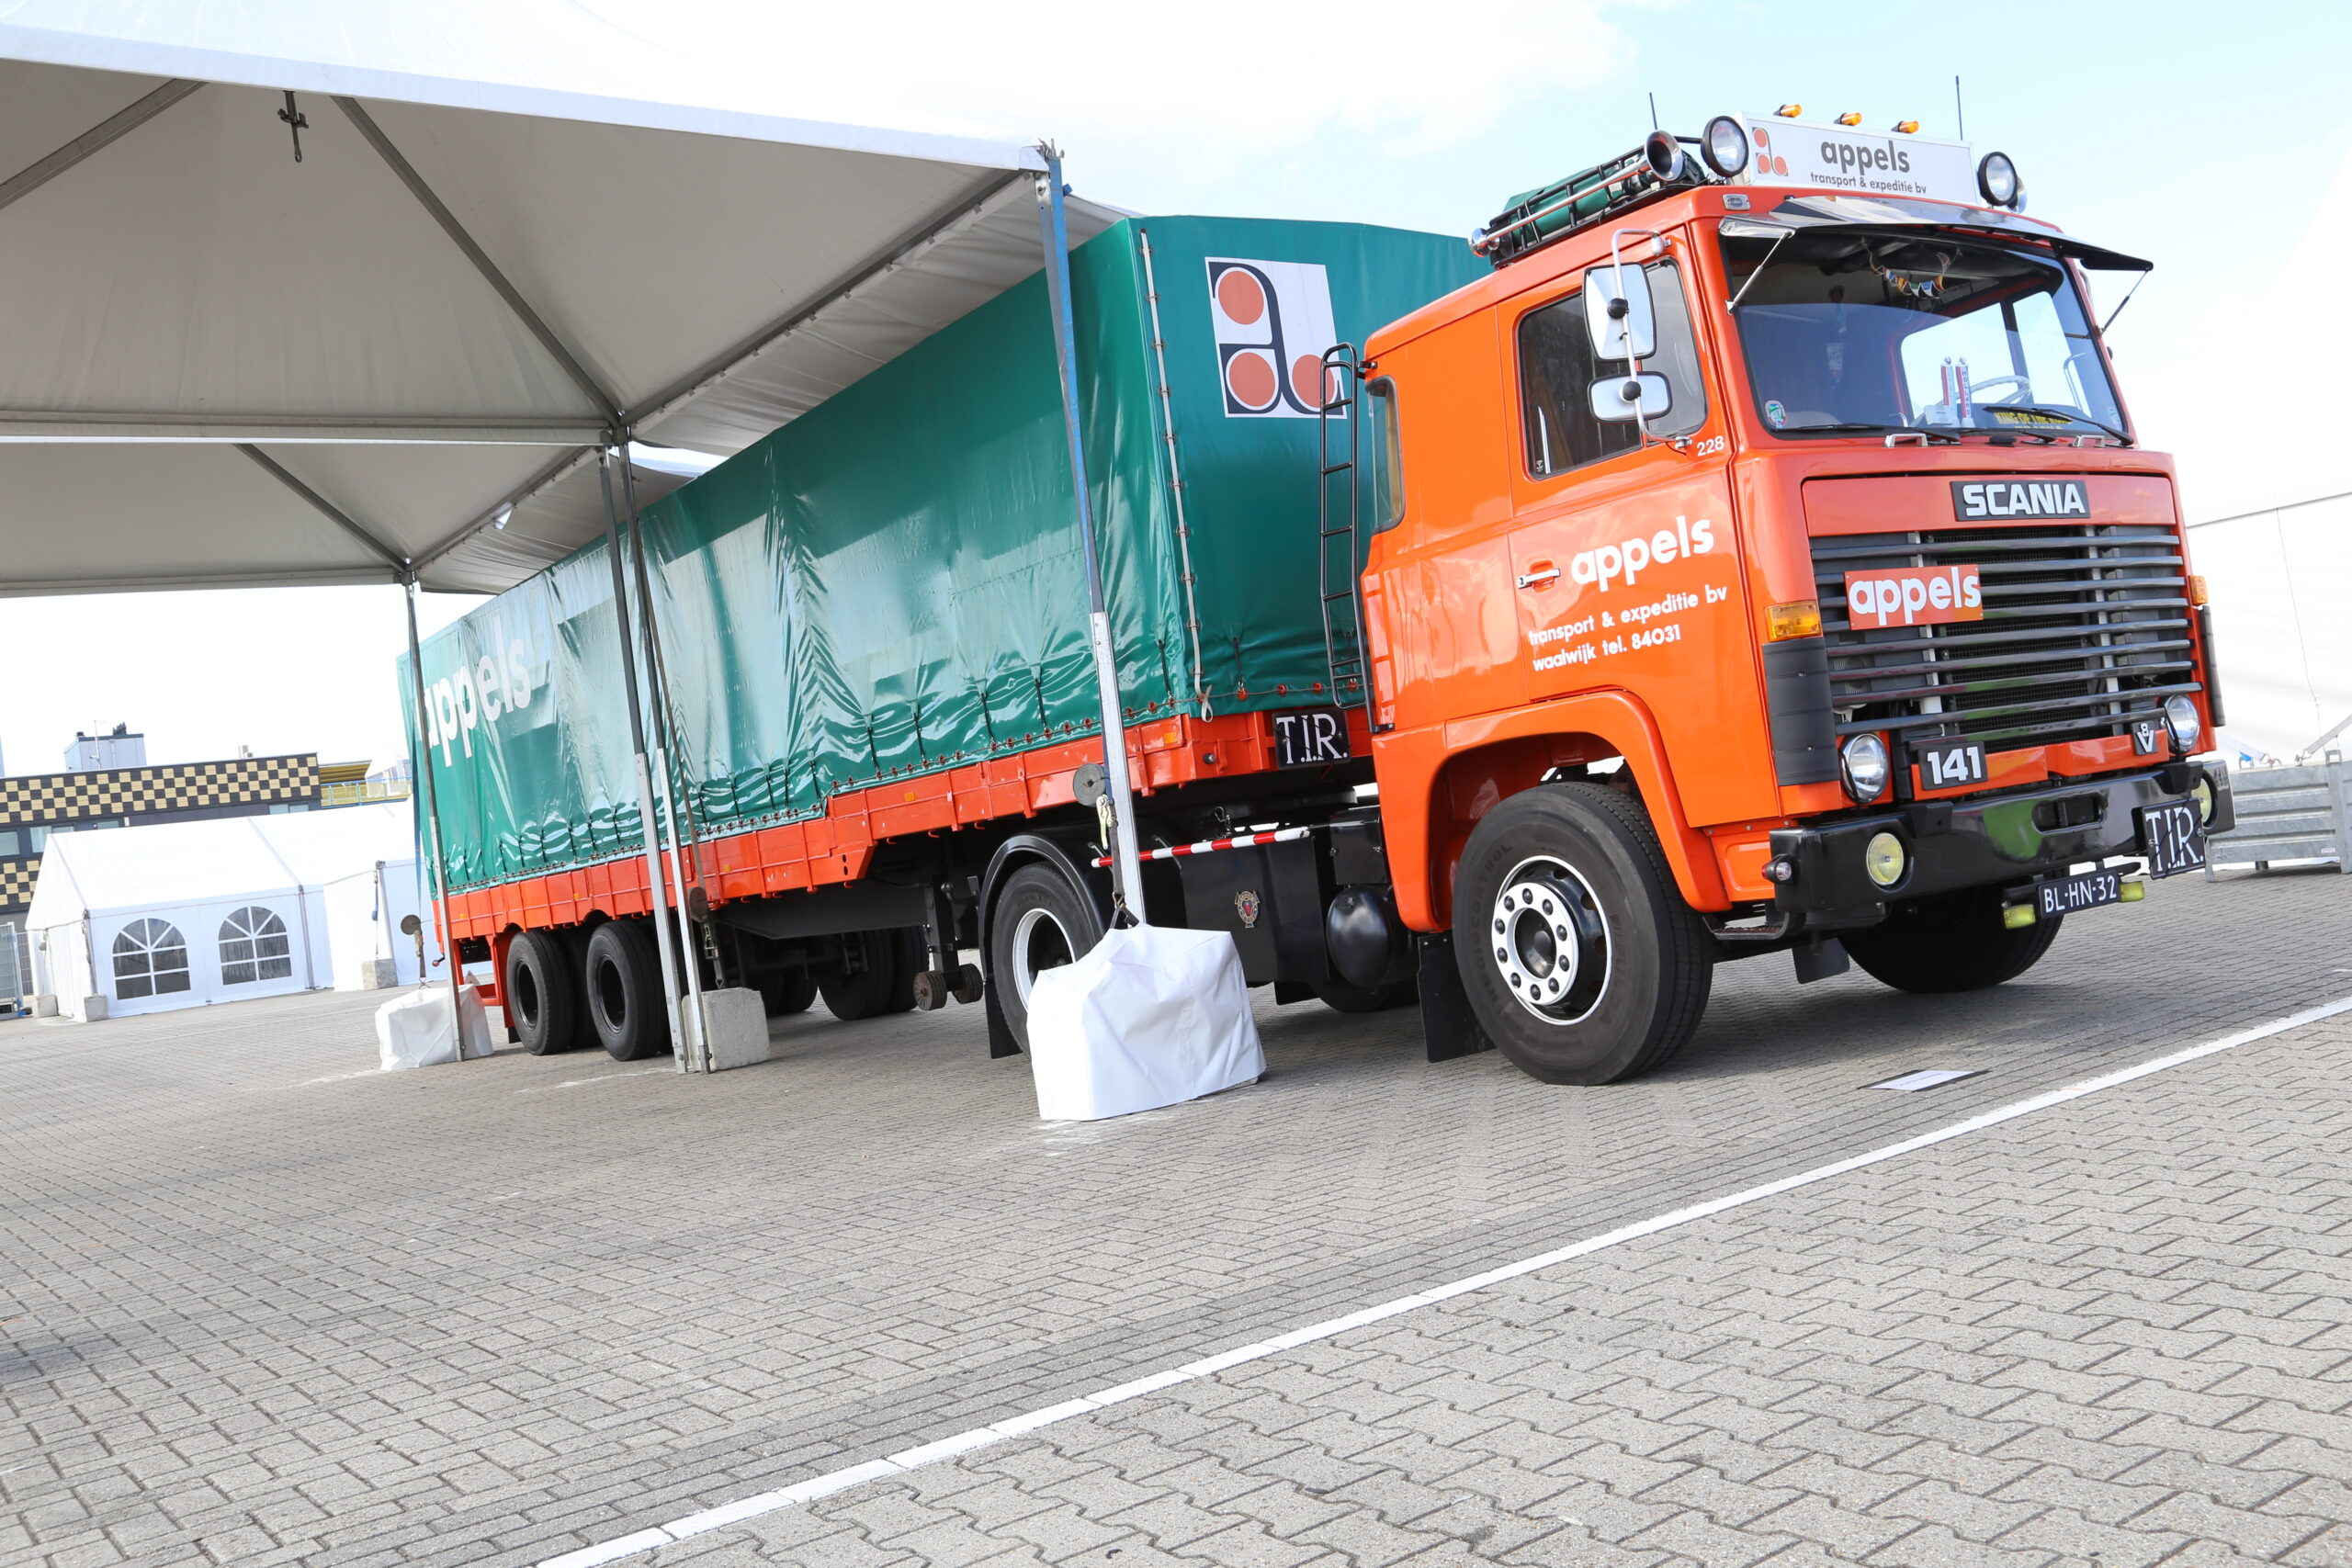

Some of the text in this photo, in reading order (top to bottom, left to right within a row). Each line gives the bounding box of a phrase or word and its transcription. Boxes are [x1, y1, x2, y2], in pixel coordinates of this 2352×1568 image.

[1821, 140, 1910, 175] appels
[1811, 172, 1927, 194] transport & expeditie bv
[1696, 435, 1724, 457] 228
[1962, 483, 2086, 516] SCANIA
[1571, 514, 1714, 592] appels
[1528, 584, 1728, 647] transport & expeditie bv
[1849, 566, 1982, 626] appels
[1532, 624, 1681, 672] waalwijk tel. 84031
[1927, 746, 1982, 785] 141
